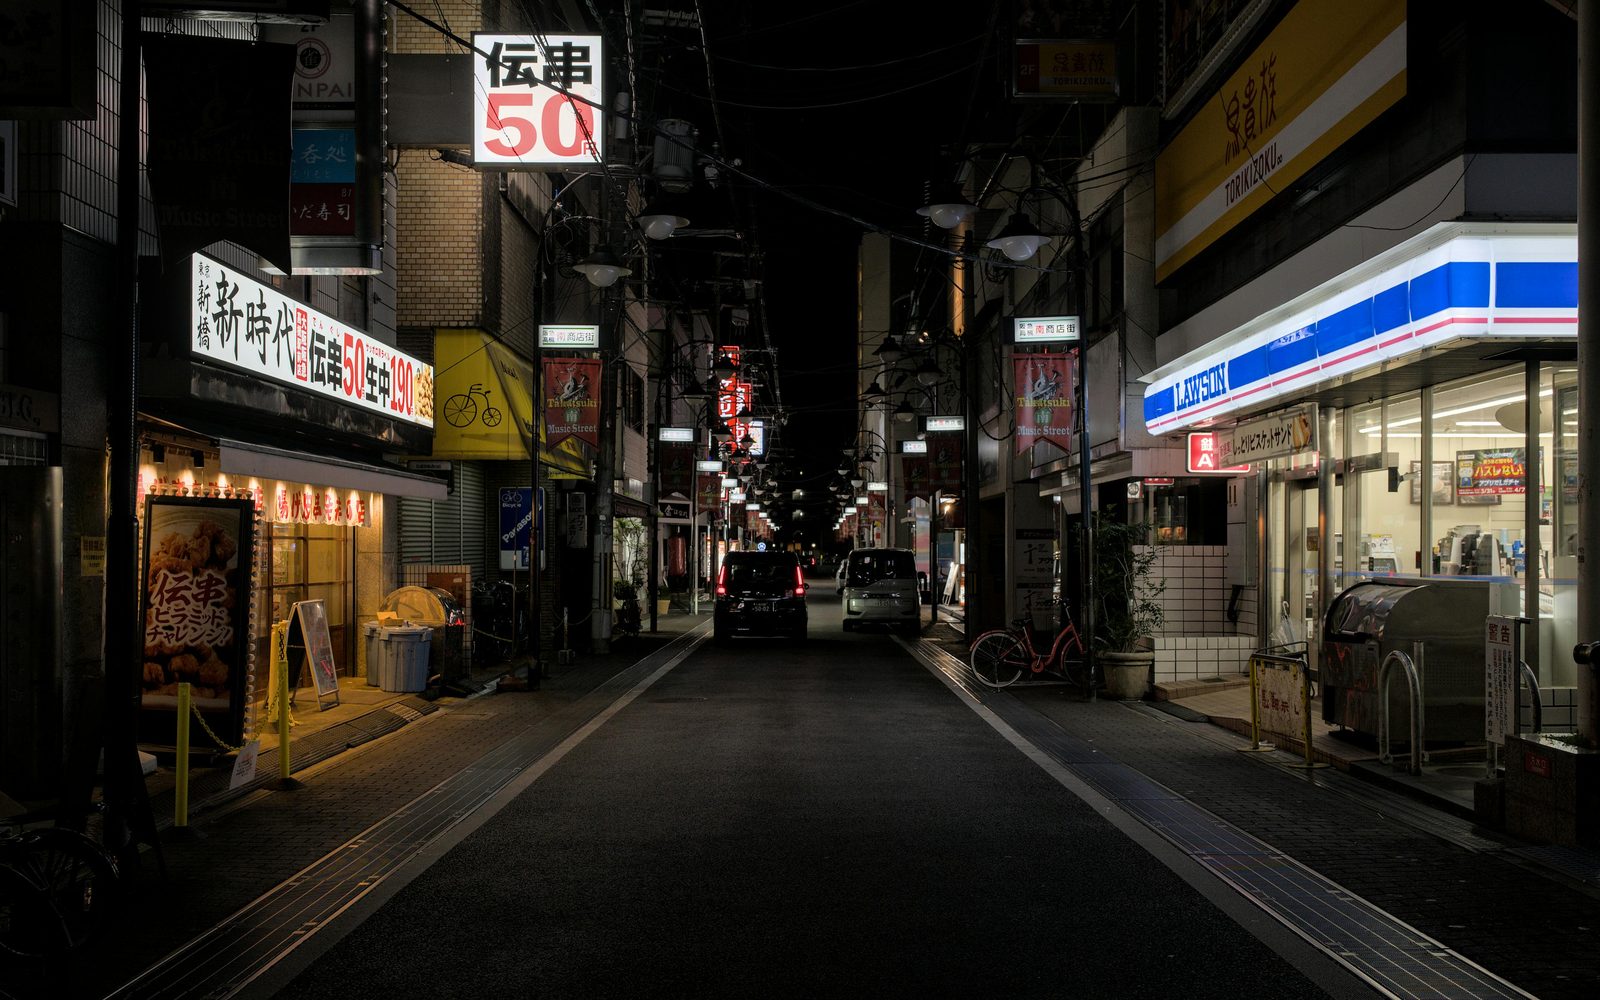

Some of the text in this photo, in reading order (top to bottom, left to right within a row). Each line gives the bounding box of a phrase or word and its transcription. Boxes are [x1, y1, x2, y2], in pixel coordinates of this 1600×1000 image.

[486, 42, 592, 88] 伝串
[297, 82, 352, 98] NPAI
[1225, 142, 1277, 207] TORIKIZOKU
[197, 280, 211, 351] 新橋
[211, 269, 296, 377] 新時代
[1175, 361, 1227, 411] LAWSON
[546, 398, 598, 408] Takatsuki
[1017, 397, 1070, 408] Takatsuki
[547, 423, 598, 434] Music Street
[1017, 425, 1070, 435] Music Street
[1232, 424, 1292, 456] しっとりビスケットサンド
[502, 504, 543, 544] Panaso
[154, 572, 228, 610] 伝串
[154, 606, 225, 629] ピラミッド
[147, 624, 233, 646] チャレンジ!
[1489, 623, 1509, 643] 警告
